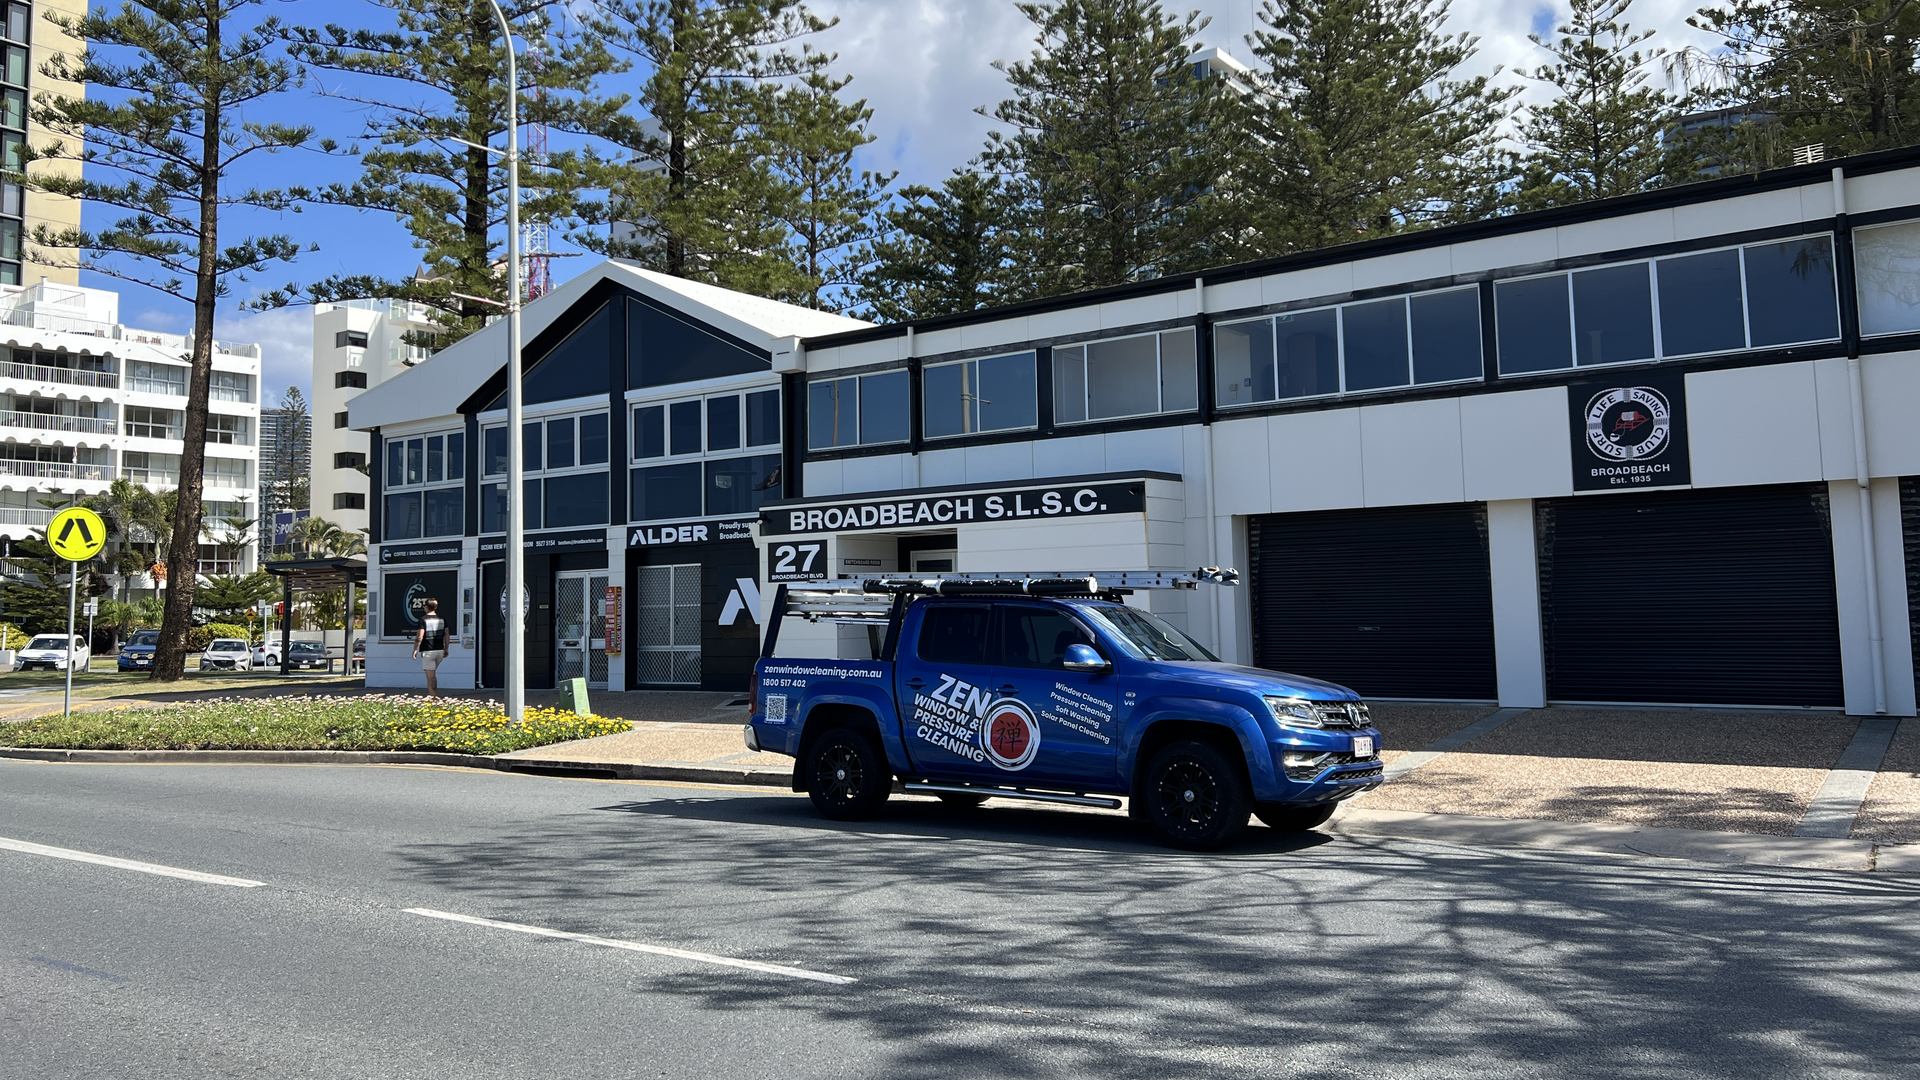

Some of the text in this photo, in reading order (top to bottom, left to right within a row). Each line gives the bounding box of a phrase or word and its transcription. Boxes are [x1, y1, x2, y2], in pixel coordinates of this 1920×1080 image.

[1592, 392, 1664, 456] SURF LIFE SAVING CLUB
[1591, 464, 1670, 476] BROADBEACH
[790, 488, 1108, 531] BROADBEACH S.L.S.C.
[630, 525, 708, 545] ALDER
[719, 522, 741, 530] Proudly
[776, 544, 820, 573] 27
[763, 678, 779, 686] 1800
[764, 665, 882, 679] zenwindowcleaning.com.au
[931, 673, 992, 718] ZEN
[1050, 692, 1111, 722] Pressure Cleaning
[1055, 682, 1113, 712] Window Cleaning
[914, 693, 980, 730] WINDOW &
[914, 709, 974, 742] PRESSURE
[1055, 705, 1100, 729] Soft Washing
[1041, 710, 1110, 744] Solar Panel Cleaning
[917, 726, 985, 762] CLEANING
